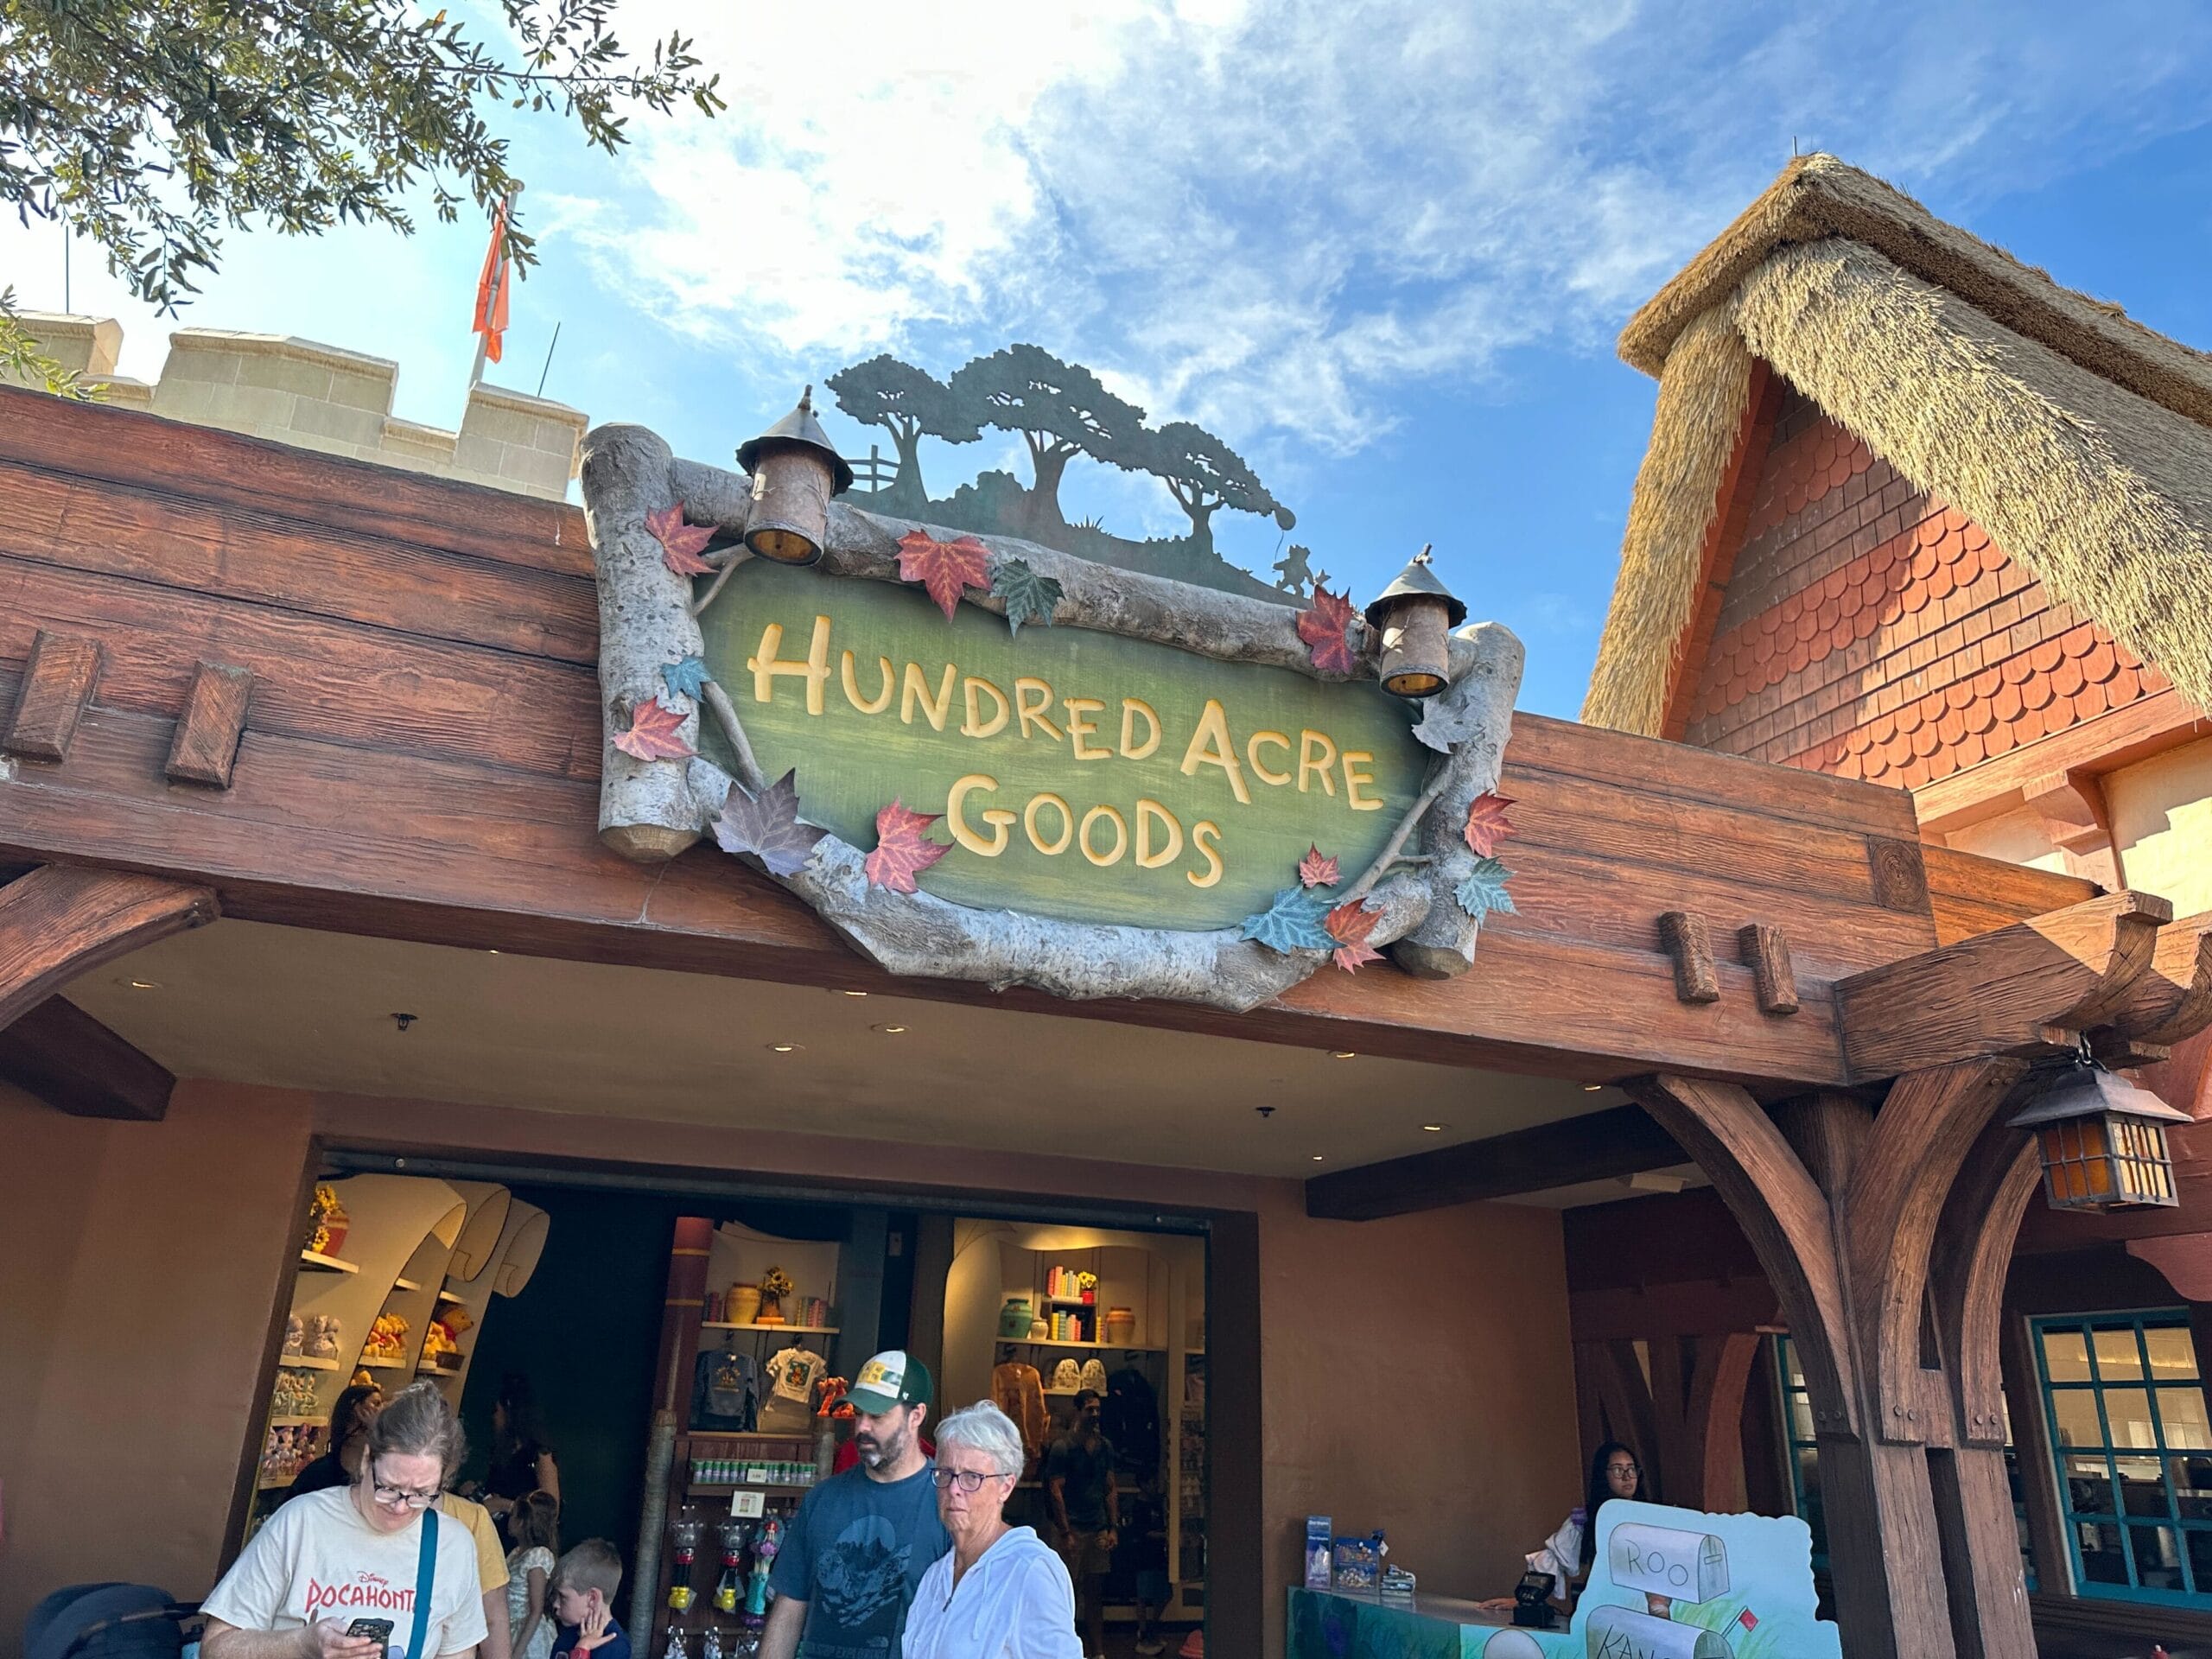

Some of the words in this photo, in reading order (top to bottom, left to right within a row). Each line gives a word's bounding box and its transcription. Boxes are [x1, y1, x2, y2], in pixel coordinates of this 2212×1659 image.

[747, 615, 1163, 761] HUNDRED
[1180, 699, 1383, 811] ACRE
[947, 773, 1224, 889] GOODS
[356, 1570, 389, 1588] Disney
[1624, 1539, 1688, 1586] ROO
[304, 1577, 416, 1614] POCAHONT
